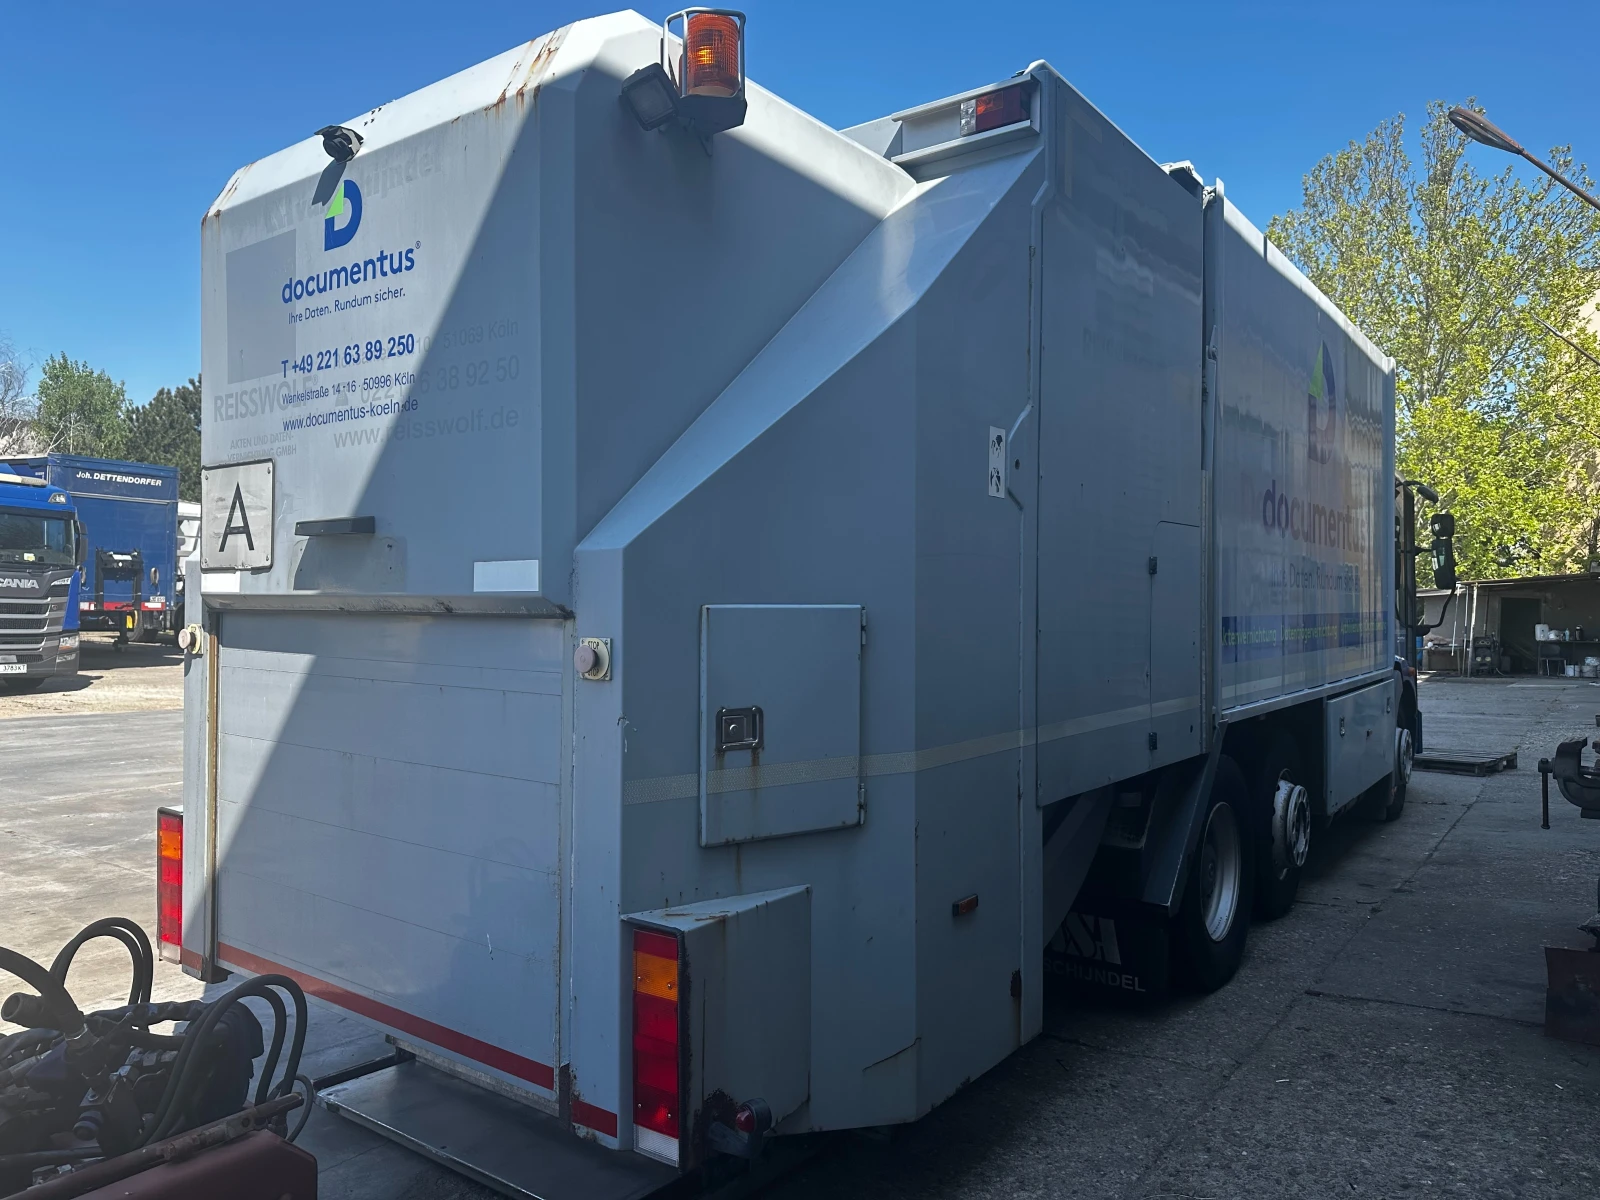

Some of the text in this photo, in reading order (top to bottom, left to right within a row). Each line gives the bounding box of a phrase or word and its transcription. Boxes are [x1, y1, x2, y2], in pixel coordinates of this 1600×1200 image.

[288, 286, 406, 325] Ihre Daten. Rundum sicher.
[281, 332, 415, 379] T +49 221 63 89 250
[466, 359, 489, 387] 92
[495, 354, 520, 382] 50
[282, 385, 329, 405] Wankelstraße
[362, 374, 391, 391] 50996
[394, 372, 415, 387] Köln
[282, 397, 419, 432] www.documentus-koeln.de
[76, 470, 162, 487] Joh. DETTENDORFER
[218, 481, 255, 553] A
[1262, 479, 1366, 554] documentus
